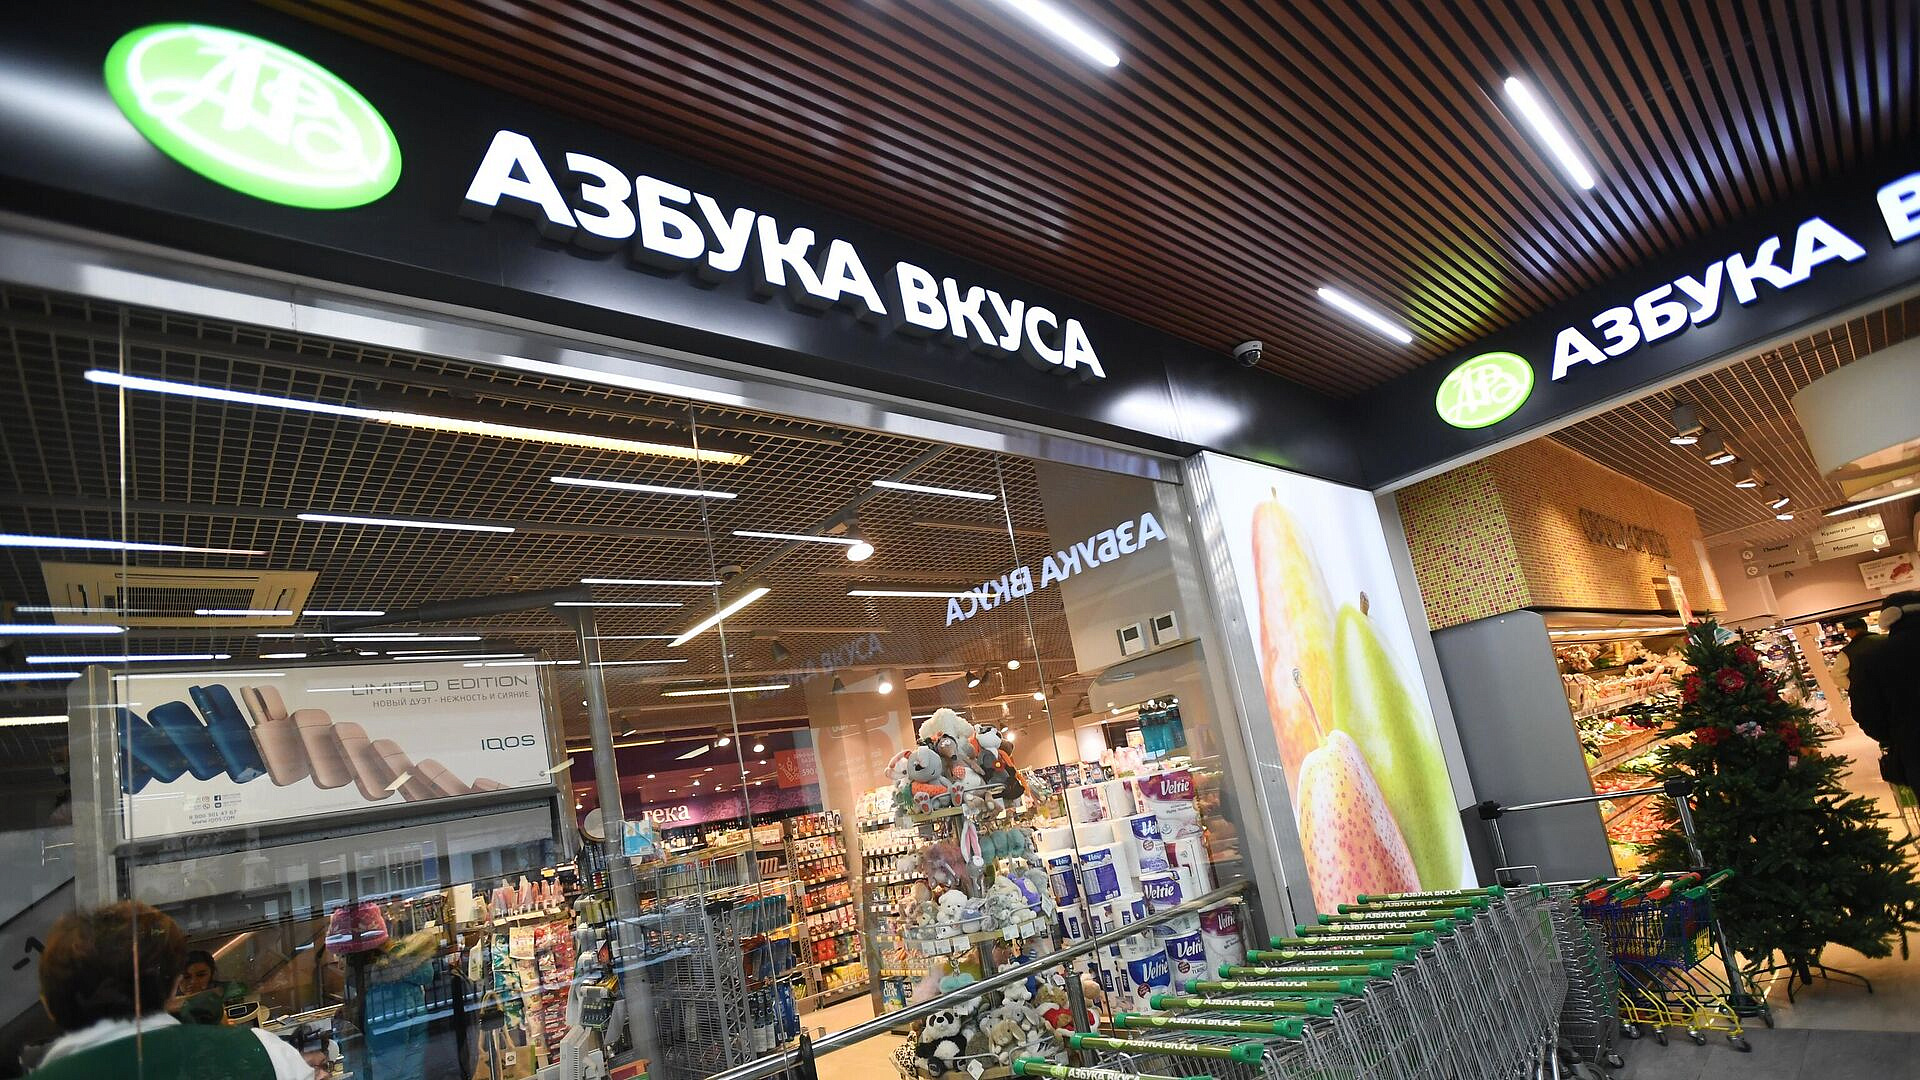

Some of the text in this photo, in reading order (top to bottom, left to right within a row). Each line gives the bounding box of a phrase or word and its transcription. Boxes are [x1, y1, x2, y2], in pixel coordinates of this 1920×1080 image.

[464, 128, 1107, 379] АЗБУКА ВКУСА
[1551, 215, 1867, 382] АЗБУКА
[351, 675, 528, 696] LIMITED EDITION
[373, 698, 407, 708] НОВЫЙ
[409, 697, 431, 706] ДУЭТ
[441, 693, 487, 704] НЕЖНОСТЬ
[497, 690, 530, 699] СИЯНИЕ
[481, 734, 536, 751] IQOS
[1160, 779, 1190, 796] Veltie
[1144, 884, 1175, 899] Veltie
[1402, 890, 1433, 898] АЗБУКА
[1384, 900, 1416, 908] АЗБУКА
[1343, 922, 1407, 931] АЗБУКА ВКУСА
[1142, 959, 1169, 982] Veltie
